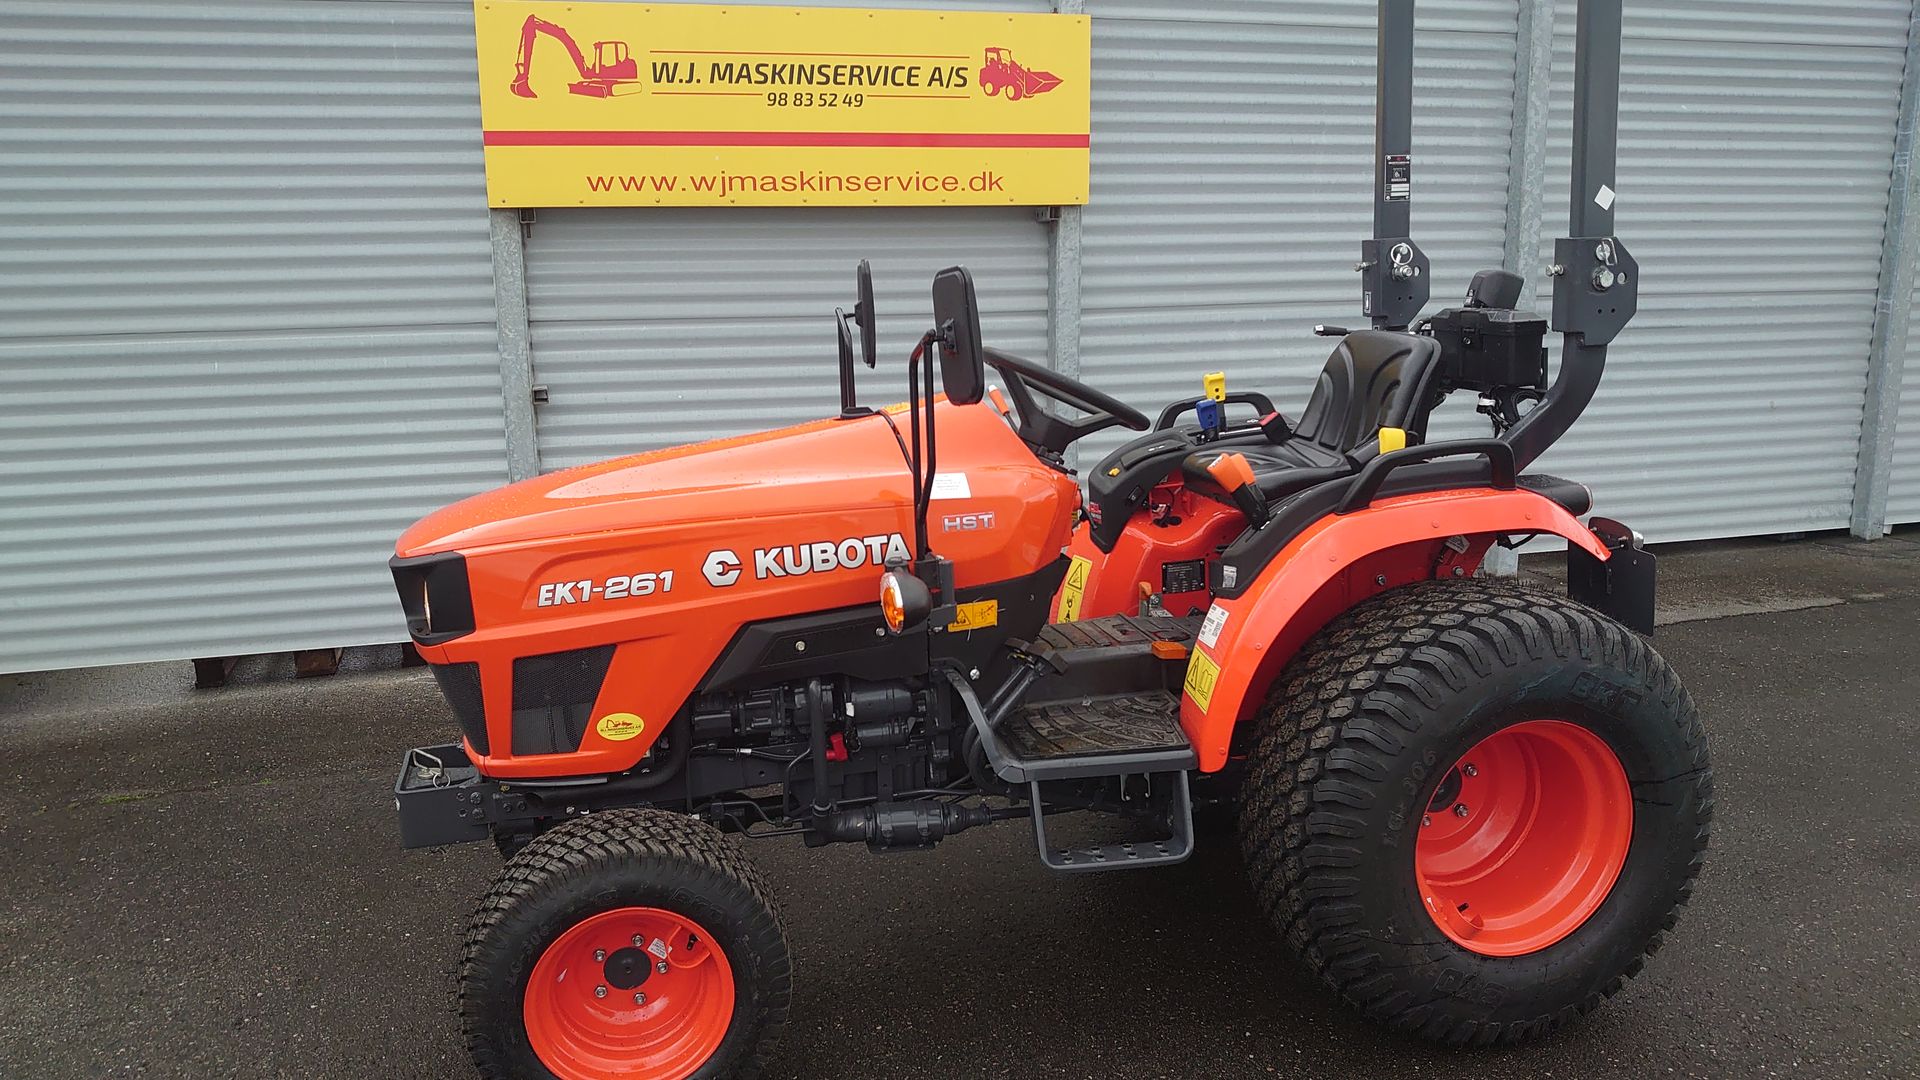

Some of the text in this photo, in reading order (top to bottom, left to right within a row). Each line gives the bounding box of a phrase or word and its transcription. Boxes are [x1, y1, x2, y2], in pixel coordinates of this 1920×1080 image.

[651, 62, 969, 88] W.J. MASKINSERVICE A/S
[767, 92, 864, 108] 98 83 52 49
[586, 170, 1004, 197] www.wjmaskinservice.dk
[943, 513, 993, 532] HST
[754, 532, 912, 580] KUBOTA
[538, 569, 674, 608] EK1-261
